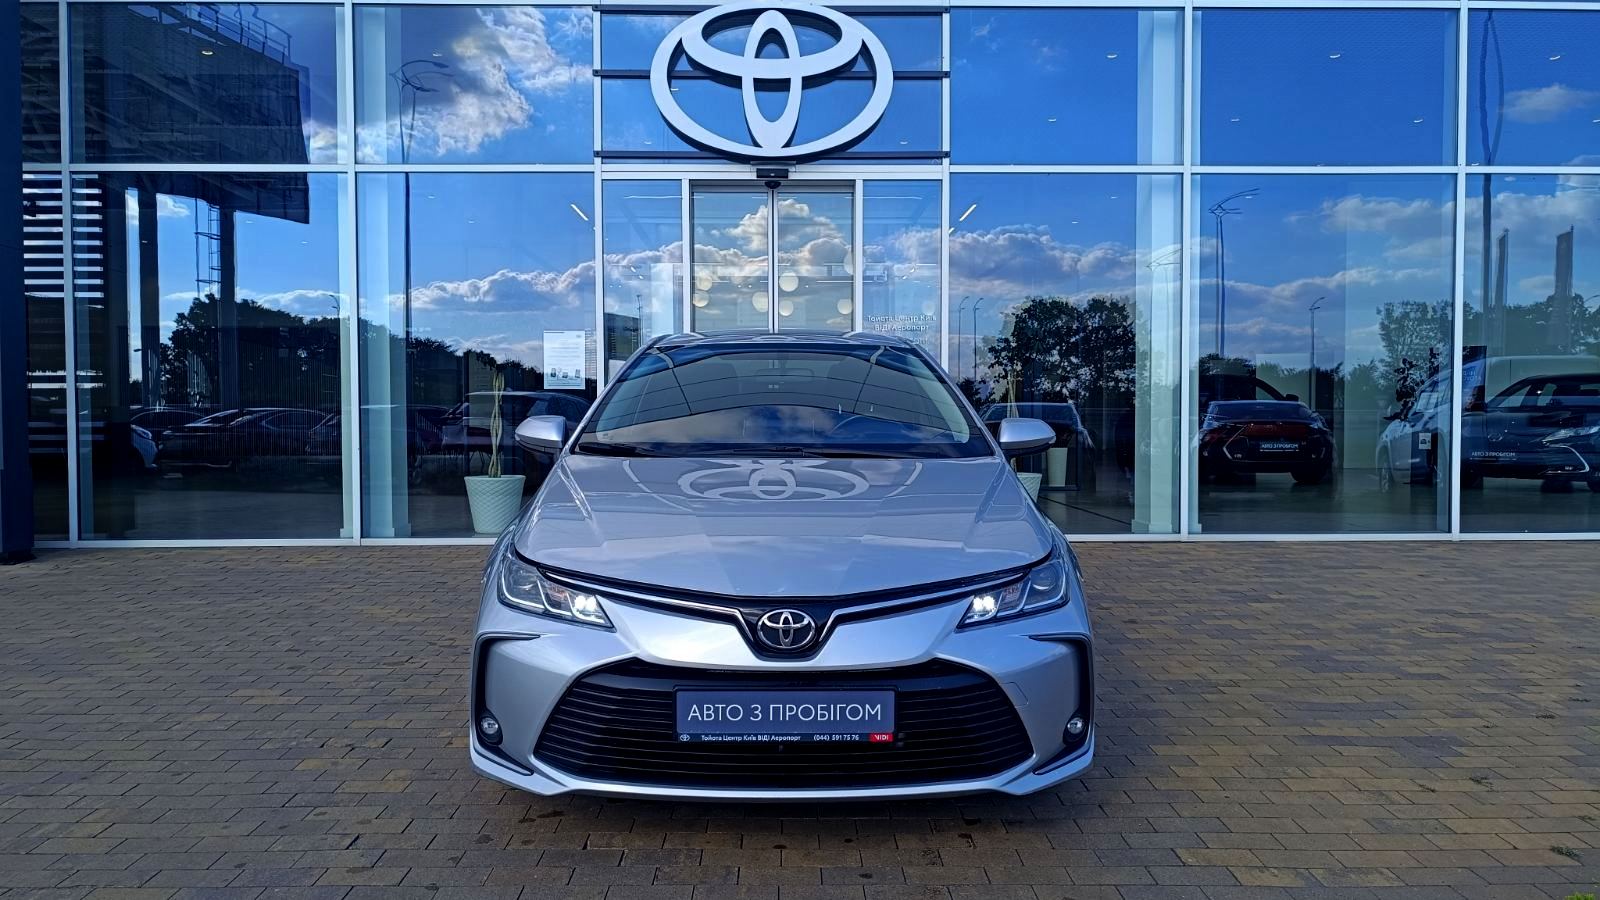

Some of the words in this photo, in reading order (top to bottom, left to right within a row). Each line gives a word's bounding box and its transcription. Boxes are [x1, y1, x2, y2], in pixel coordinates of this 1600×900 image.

[687, 704, 744, 721] АВТО
[750, 704, 762, 721] З
[769, 703, 882, 721] ПРОБІГОМ
[723, 734, 743, 742] Центр
[758, 734, 770, 742] ВІДІ
[771, 734, 801, 742] Аеропорт
[813, 734, 830, 742] (044)
